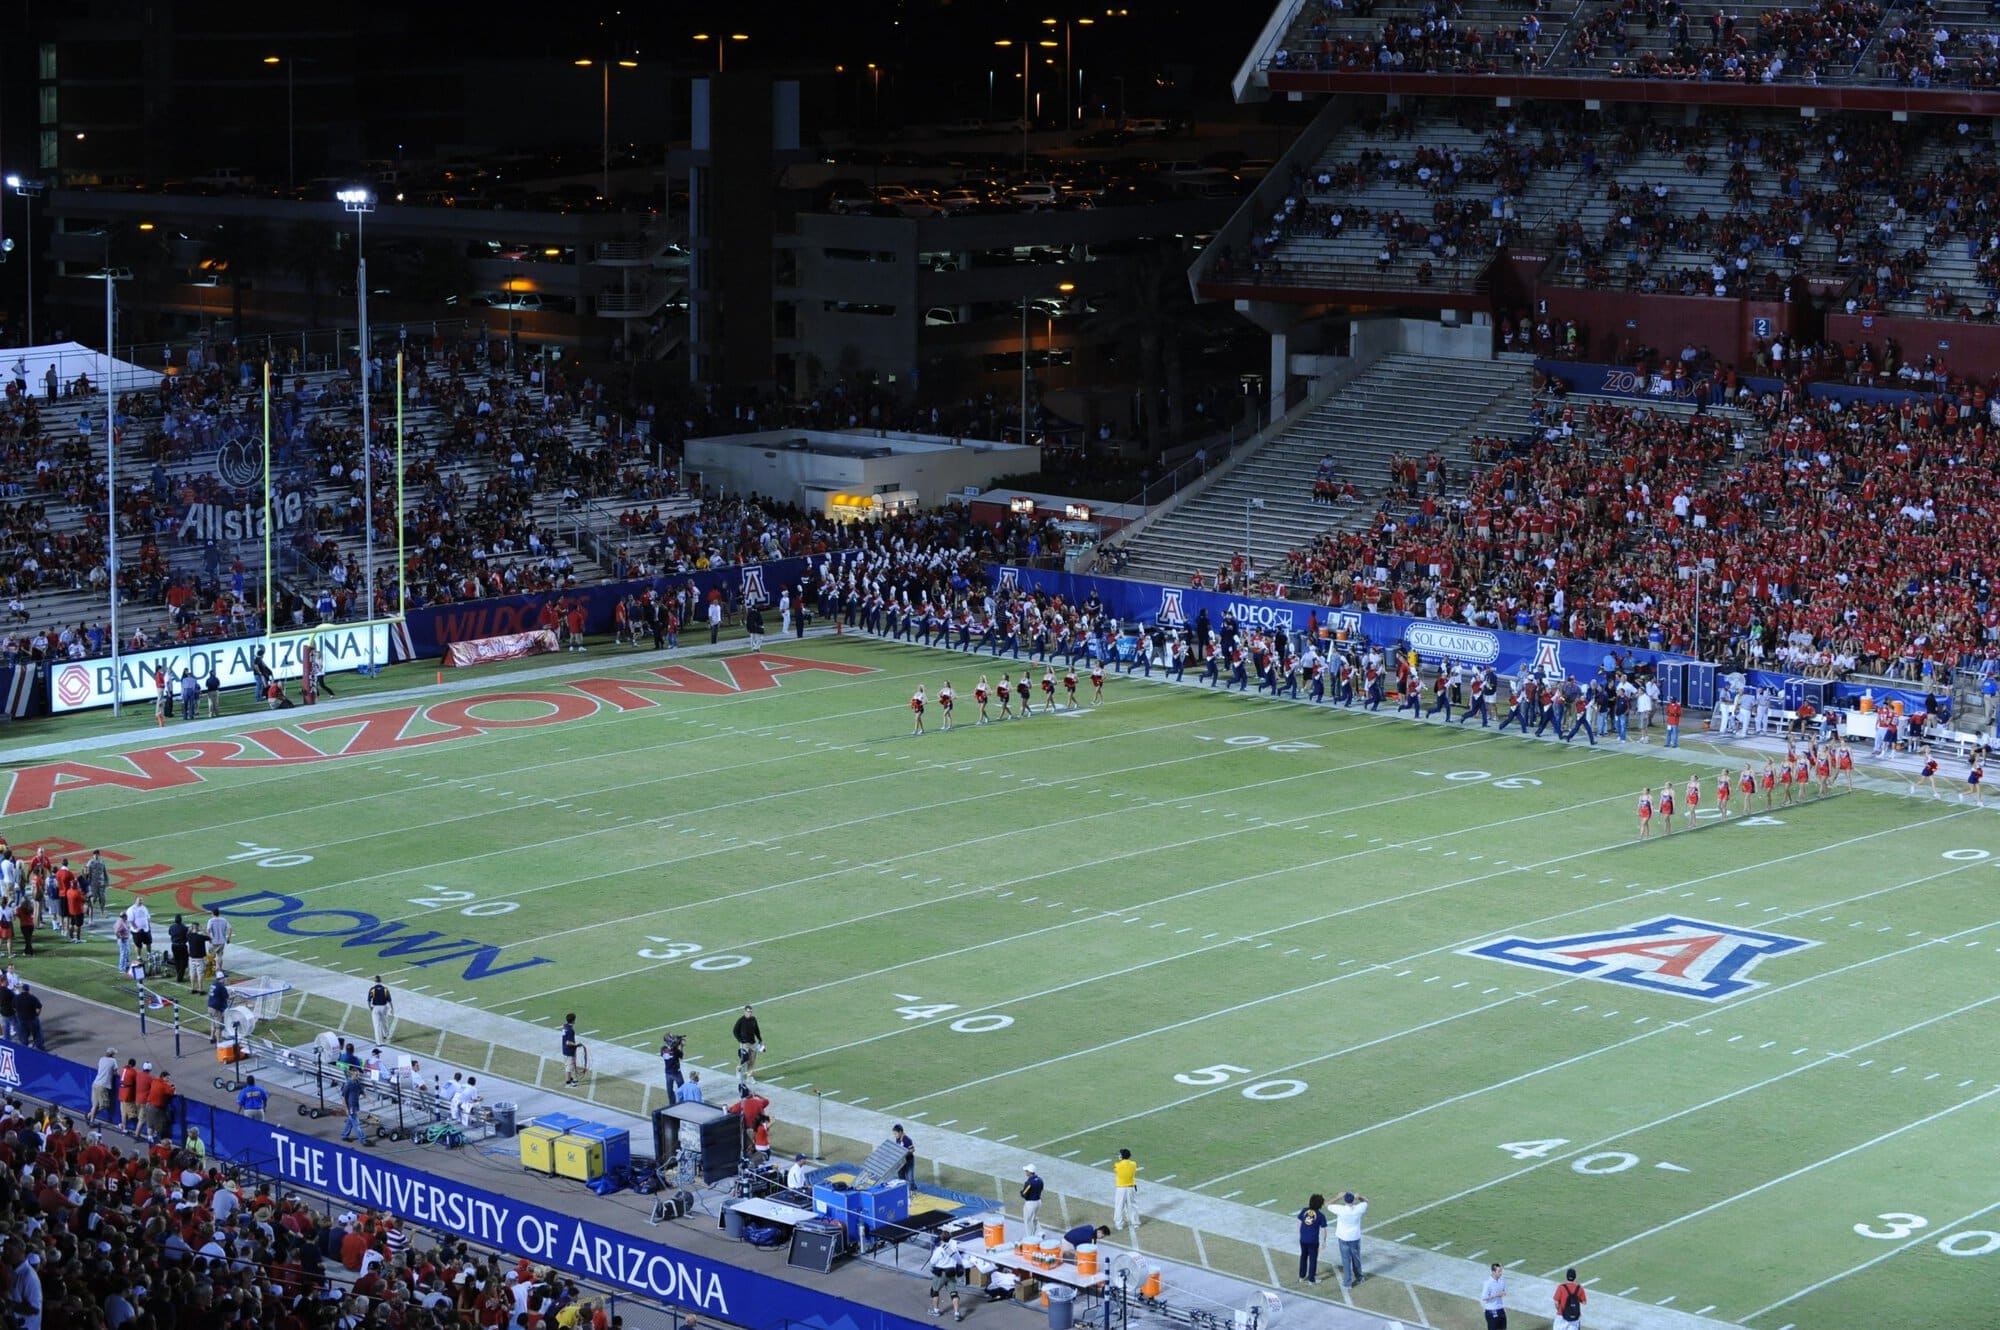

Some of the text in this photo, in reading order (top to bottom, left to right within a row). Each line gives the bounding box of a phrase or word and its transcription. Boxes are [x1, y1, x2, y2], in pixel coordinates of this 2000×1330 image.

[178, 491, 302, 540] Allstate
[1156, 588, 1184, 628] A
[1228, 602, 1273, 630] ADEQ
[1414, 632, 1490, 654] SOL CASINOS
[1528, 637, 1566, 681] A
[190, 649, 225, 680] OF
[1, 652, 884, 816] ARIZONA
[226, 847, 314, 868] 10
[408, 890, 521, 916] 20
[201, 890, 555, 981] DOWN
[637, 943, 753, 971] 30
[1456, 914, 1825, 1002] A
[895, 1003, 1015, 1033] 40
[1173, 1063, 1309, 1100] 50
[1497, 1138, 1640, 1175] 40
[108, 1177, 119, 1192] 15
[270, 1132, 729, 1316] THE UNIVERSITY OF ARIZONA
[1853, 1212, 2000, 1256] 30
